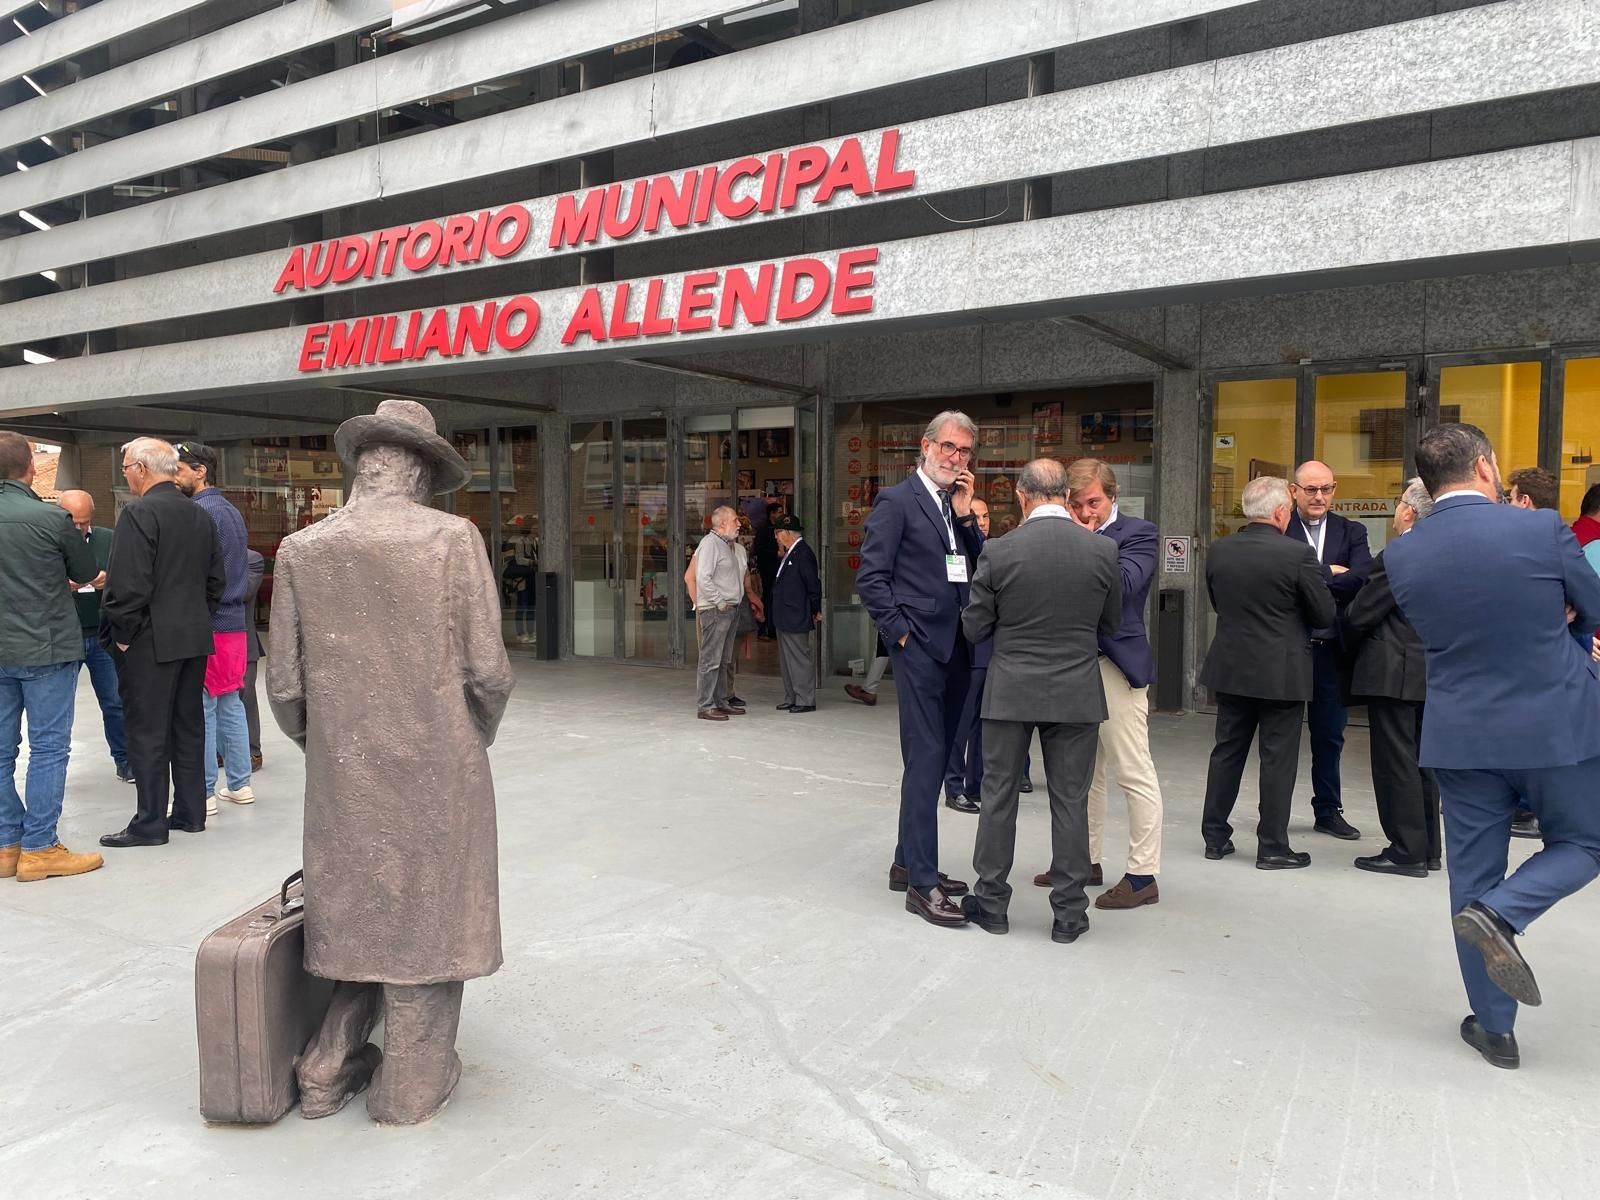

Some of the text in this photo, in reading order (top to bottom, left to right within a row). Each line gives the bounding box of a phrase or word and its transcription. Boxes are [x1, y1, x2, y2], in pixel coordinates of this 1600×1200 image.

[272, 128, 915, 294] AUDITORIO MUNICIPAL
[297, 247, 879, 373] EMILIANO ALLENDE
